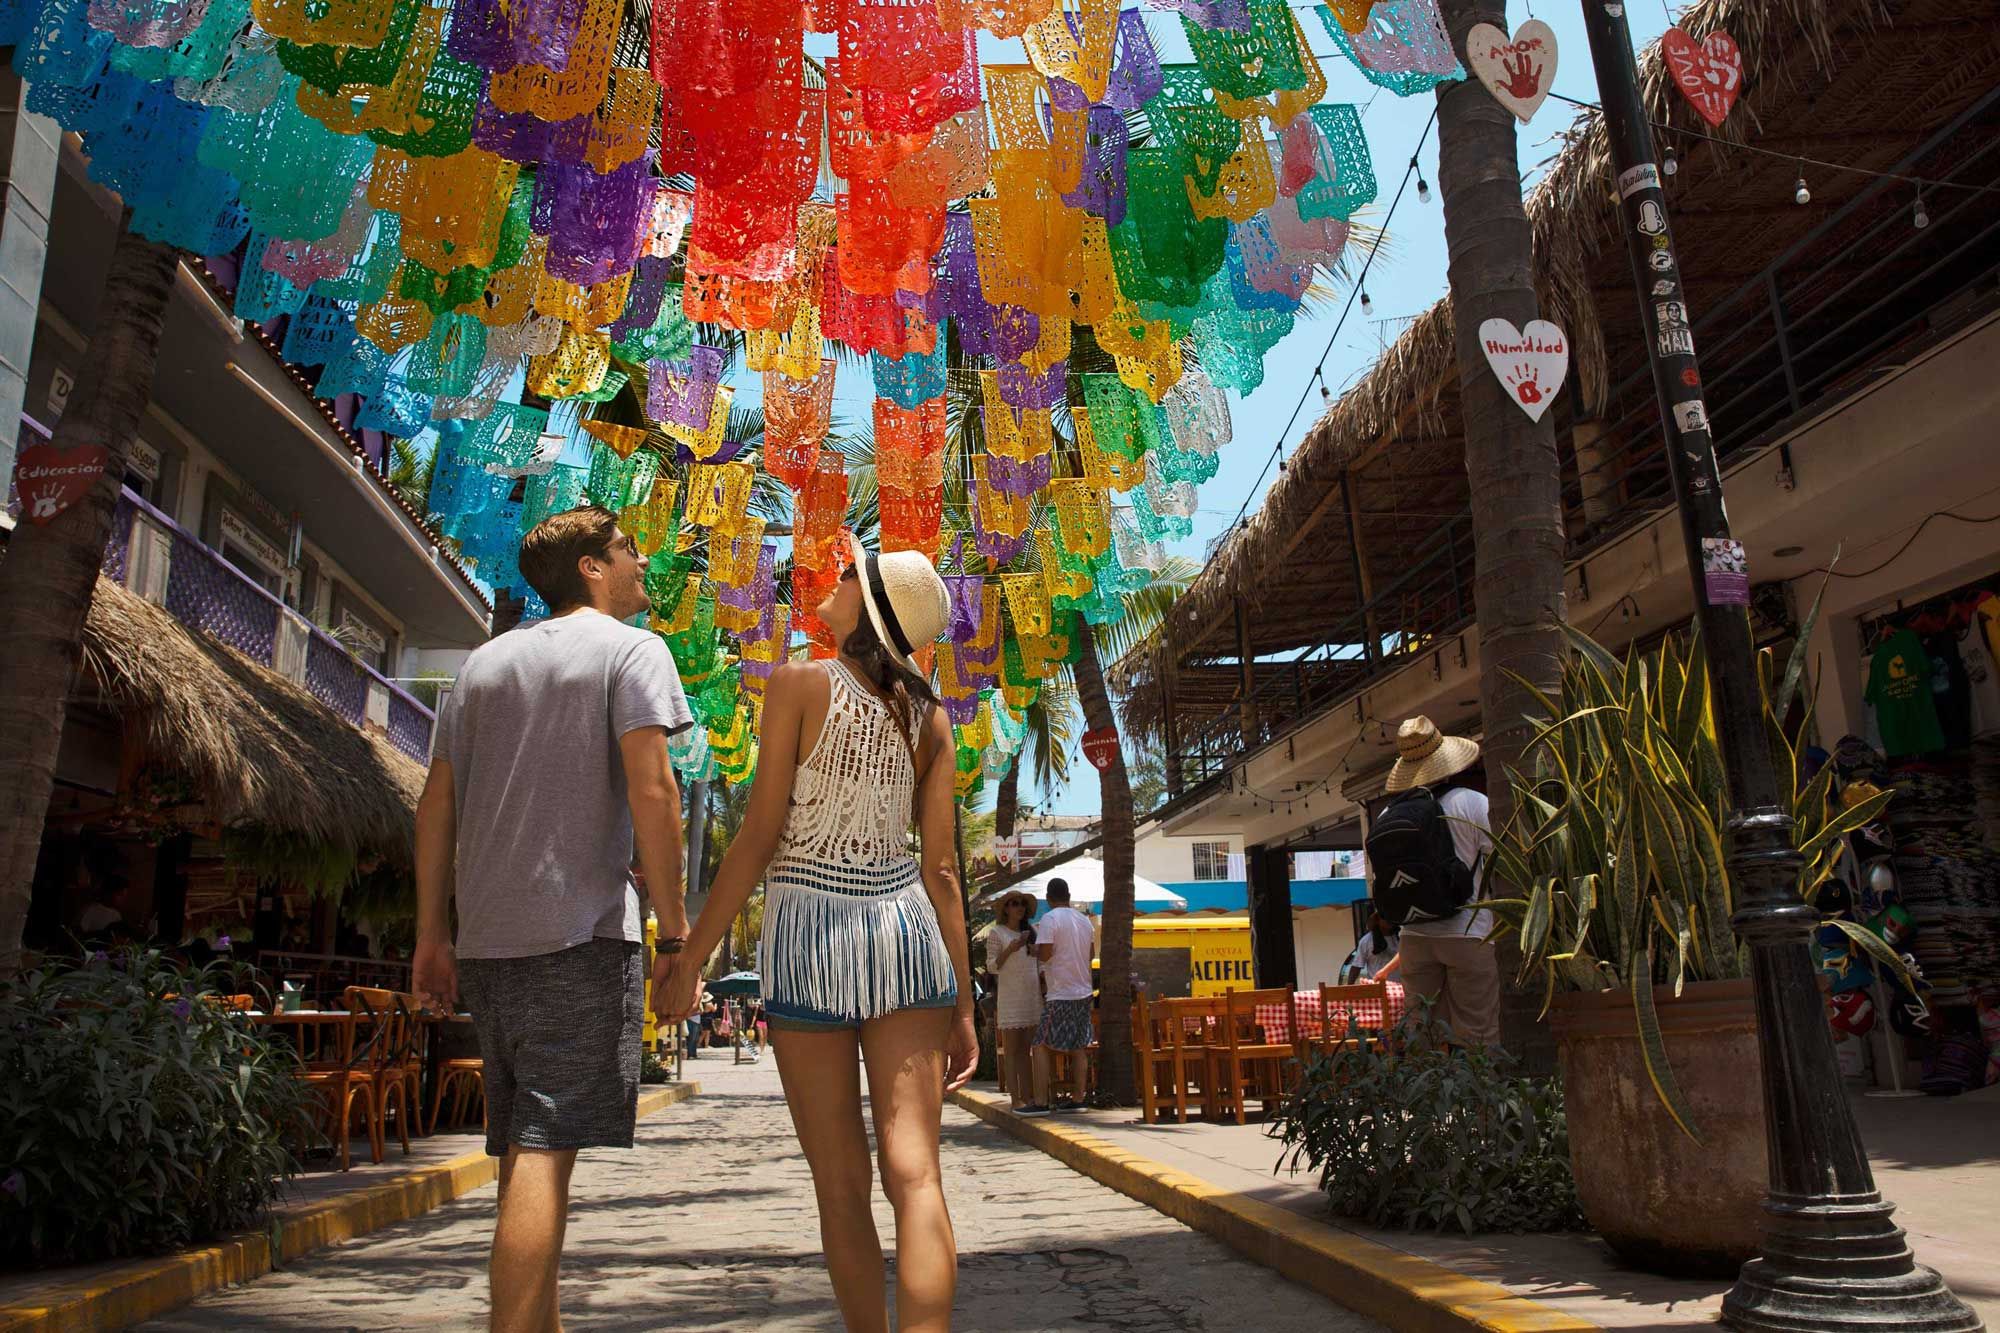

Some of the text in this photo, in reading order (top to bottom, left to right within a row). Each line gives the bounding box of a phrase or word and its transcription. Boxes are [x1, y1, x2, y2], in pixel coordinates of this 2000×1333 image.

[1490, 38, 1543, 59] AMOR
[1669, 45, 1706, 99] LOVE
[1486, 336, 1563, 354] Humildad
[18, 457, 104, 480] Educación
[1206, 946, 1242, 956] CERVEZA
[1191, 960, 1252, 981] ACIFIC
